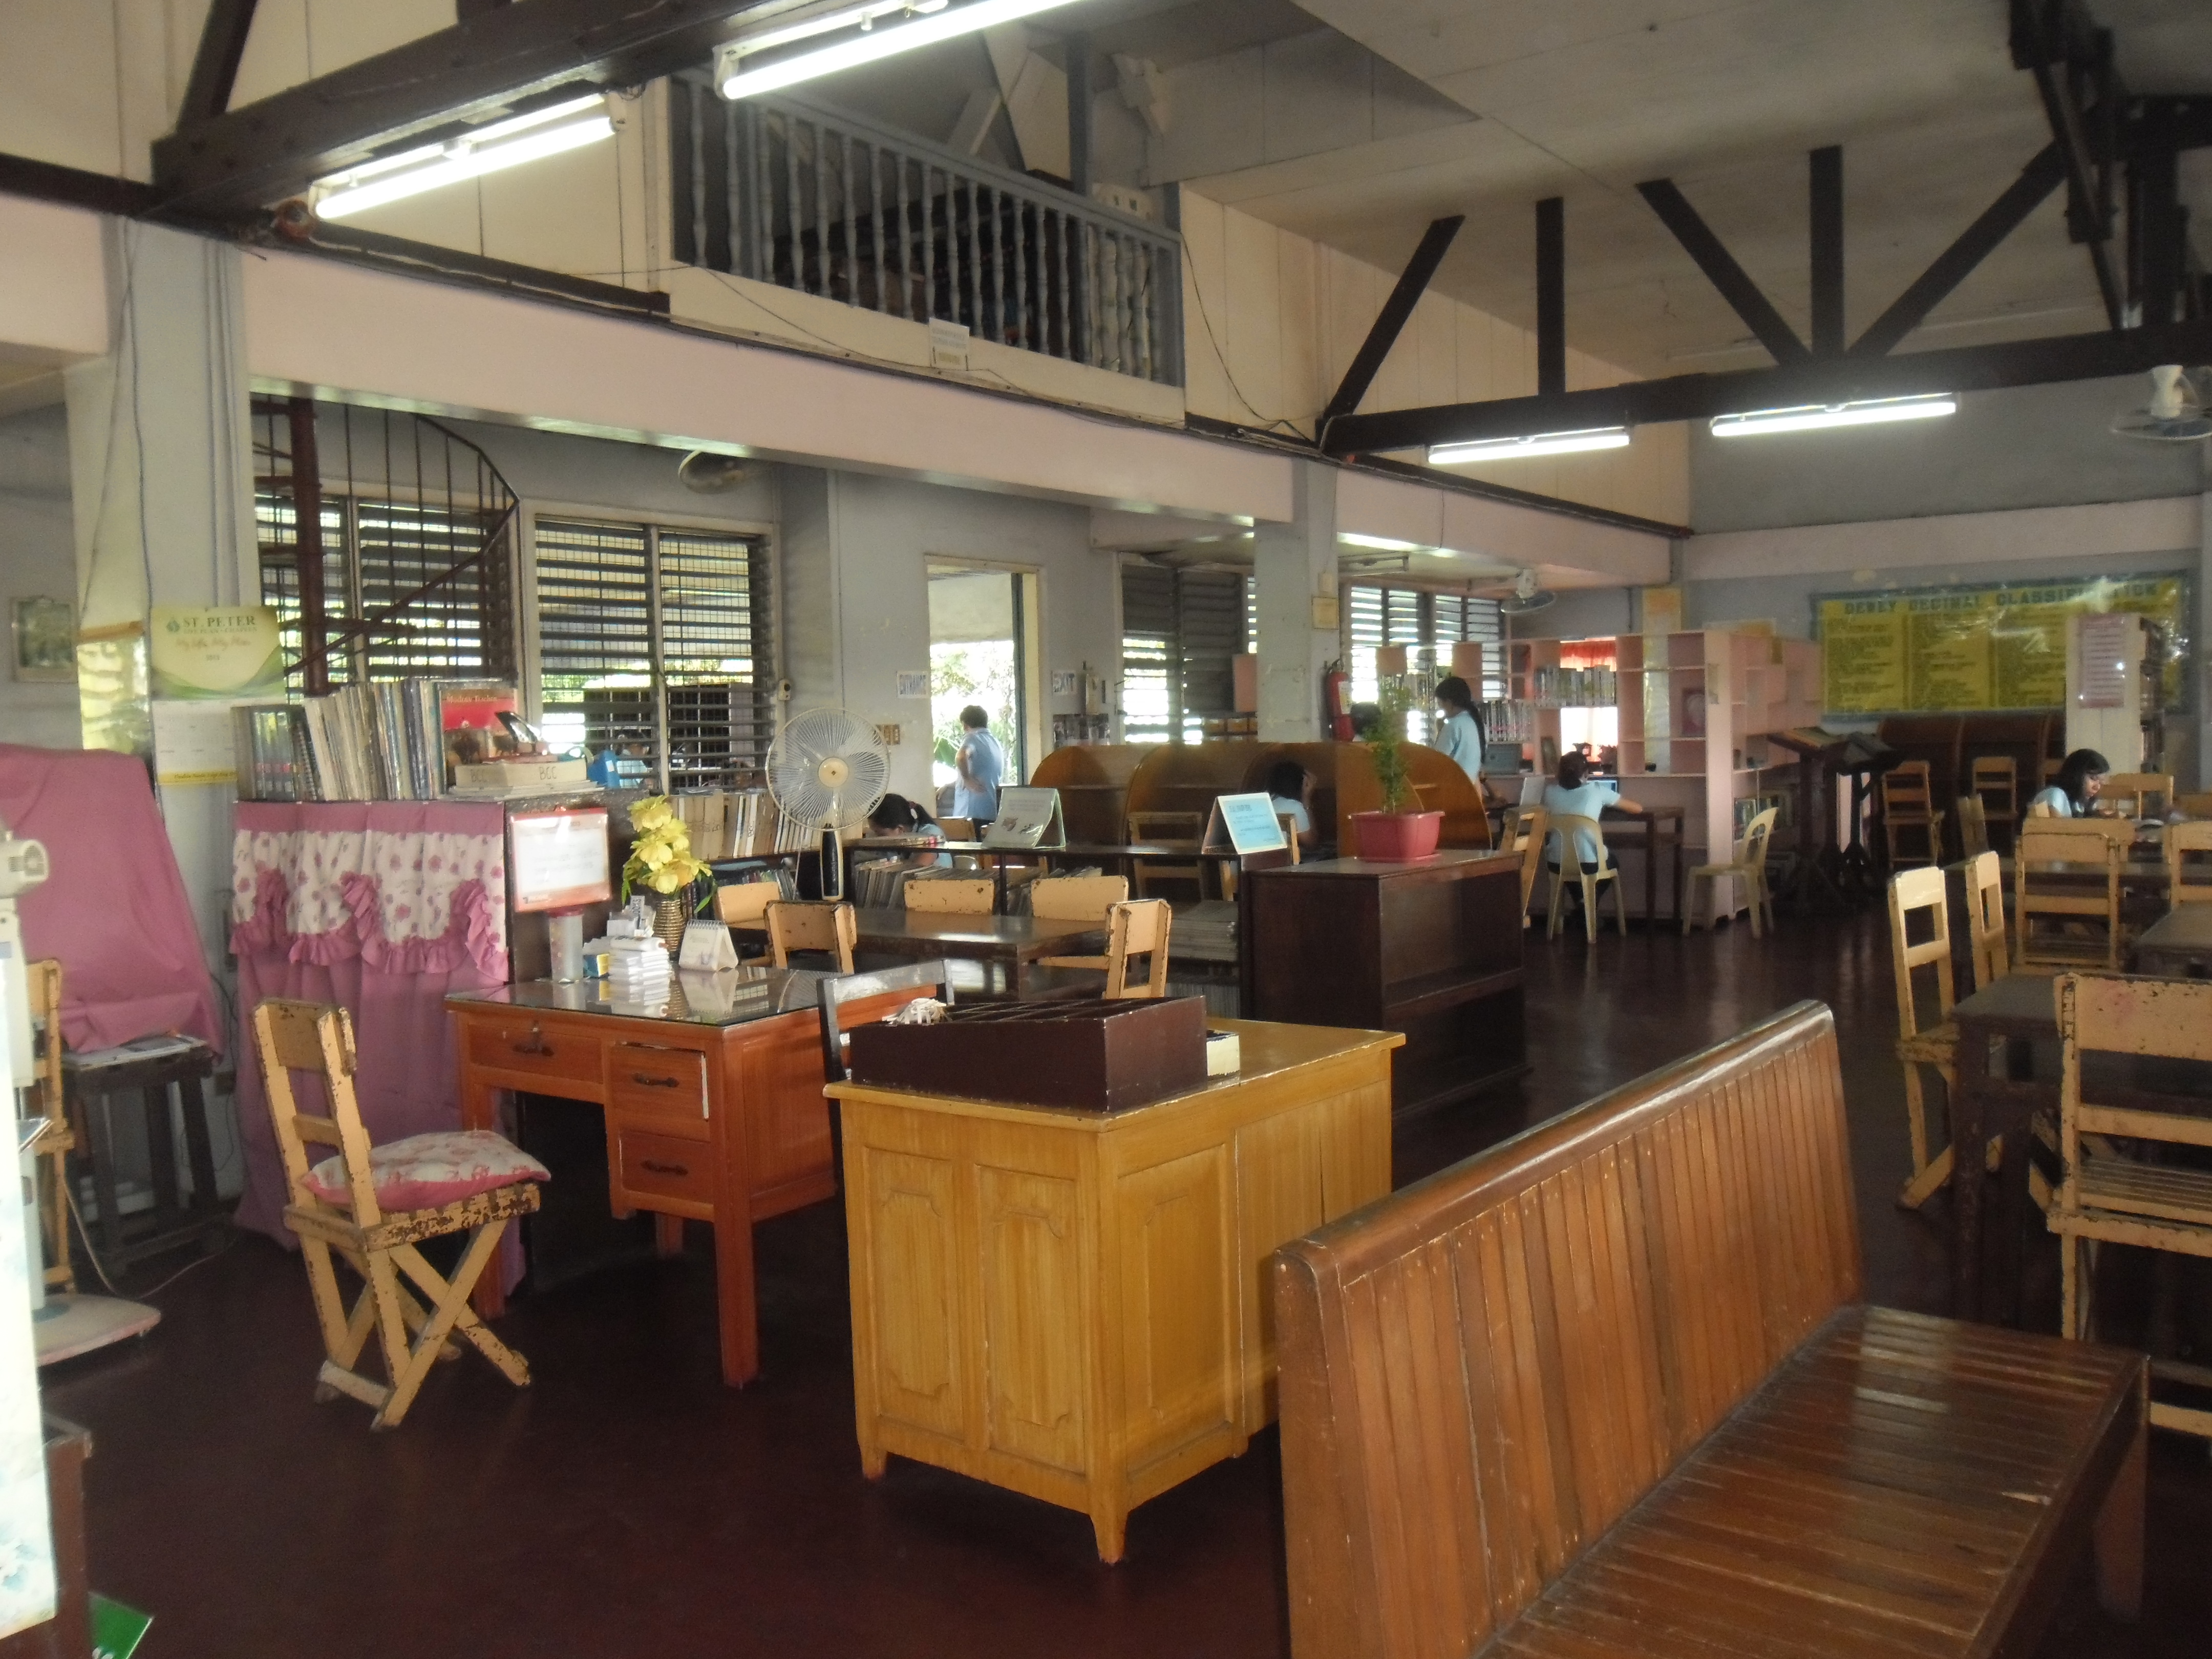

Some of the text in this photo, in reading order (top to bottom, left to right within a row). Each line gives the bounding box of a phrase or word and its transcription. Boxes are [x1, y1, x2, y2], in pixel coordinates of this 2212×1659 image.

[1844, 601, 1897, 614] DEWEY
[1908, 595, 1980, 611] DECIMAL
[207, 615, 256, 627] PETER
[539, 766, 557, 780] BCC
